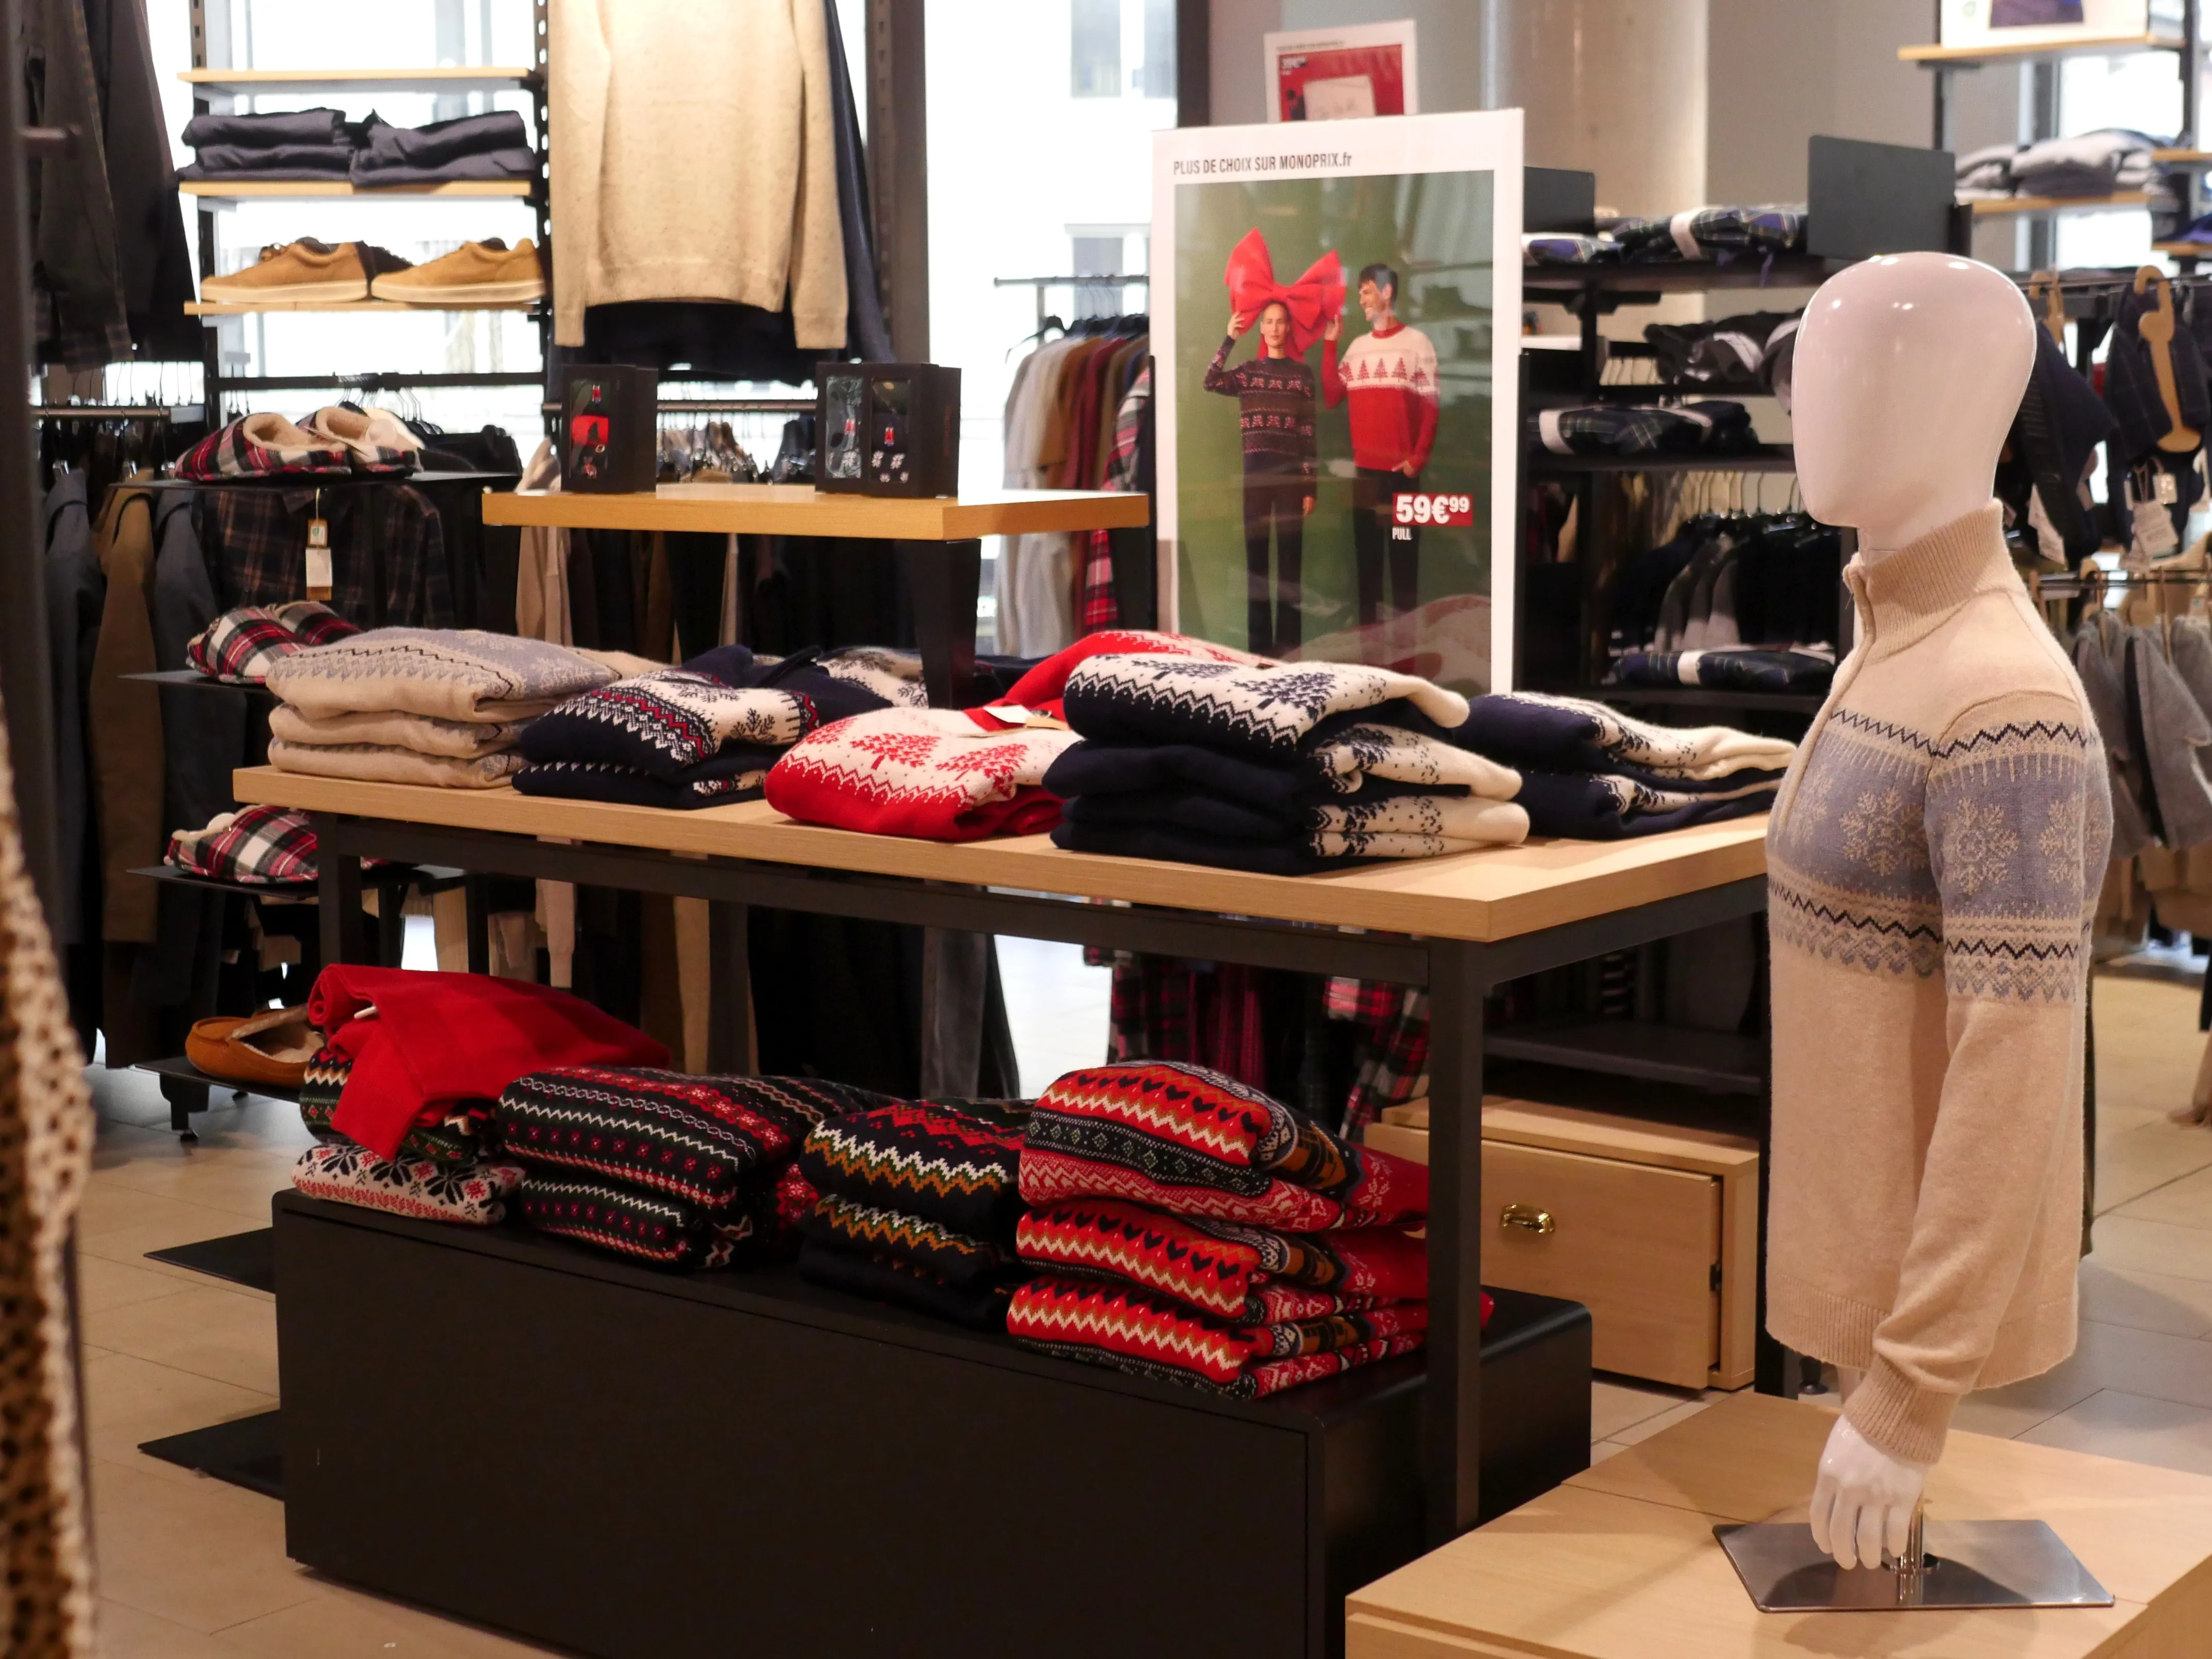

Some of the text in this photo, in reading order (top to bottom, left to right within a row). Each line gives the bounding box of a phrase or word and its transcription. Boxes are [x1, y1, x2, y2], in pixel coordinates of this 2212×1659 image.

[1174, 152, 1351, 175] PLUS DE CHOIX SUR MONOPRIX.fr
[1392, 527, 1412, 540] PULL
